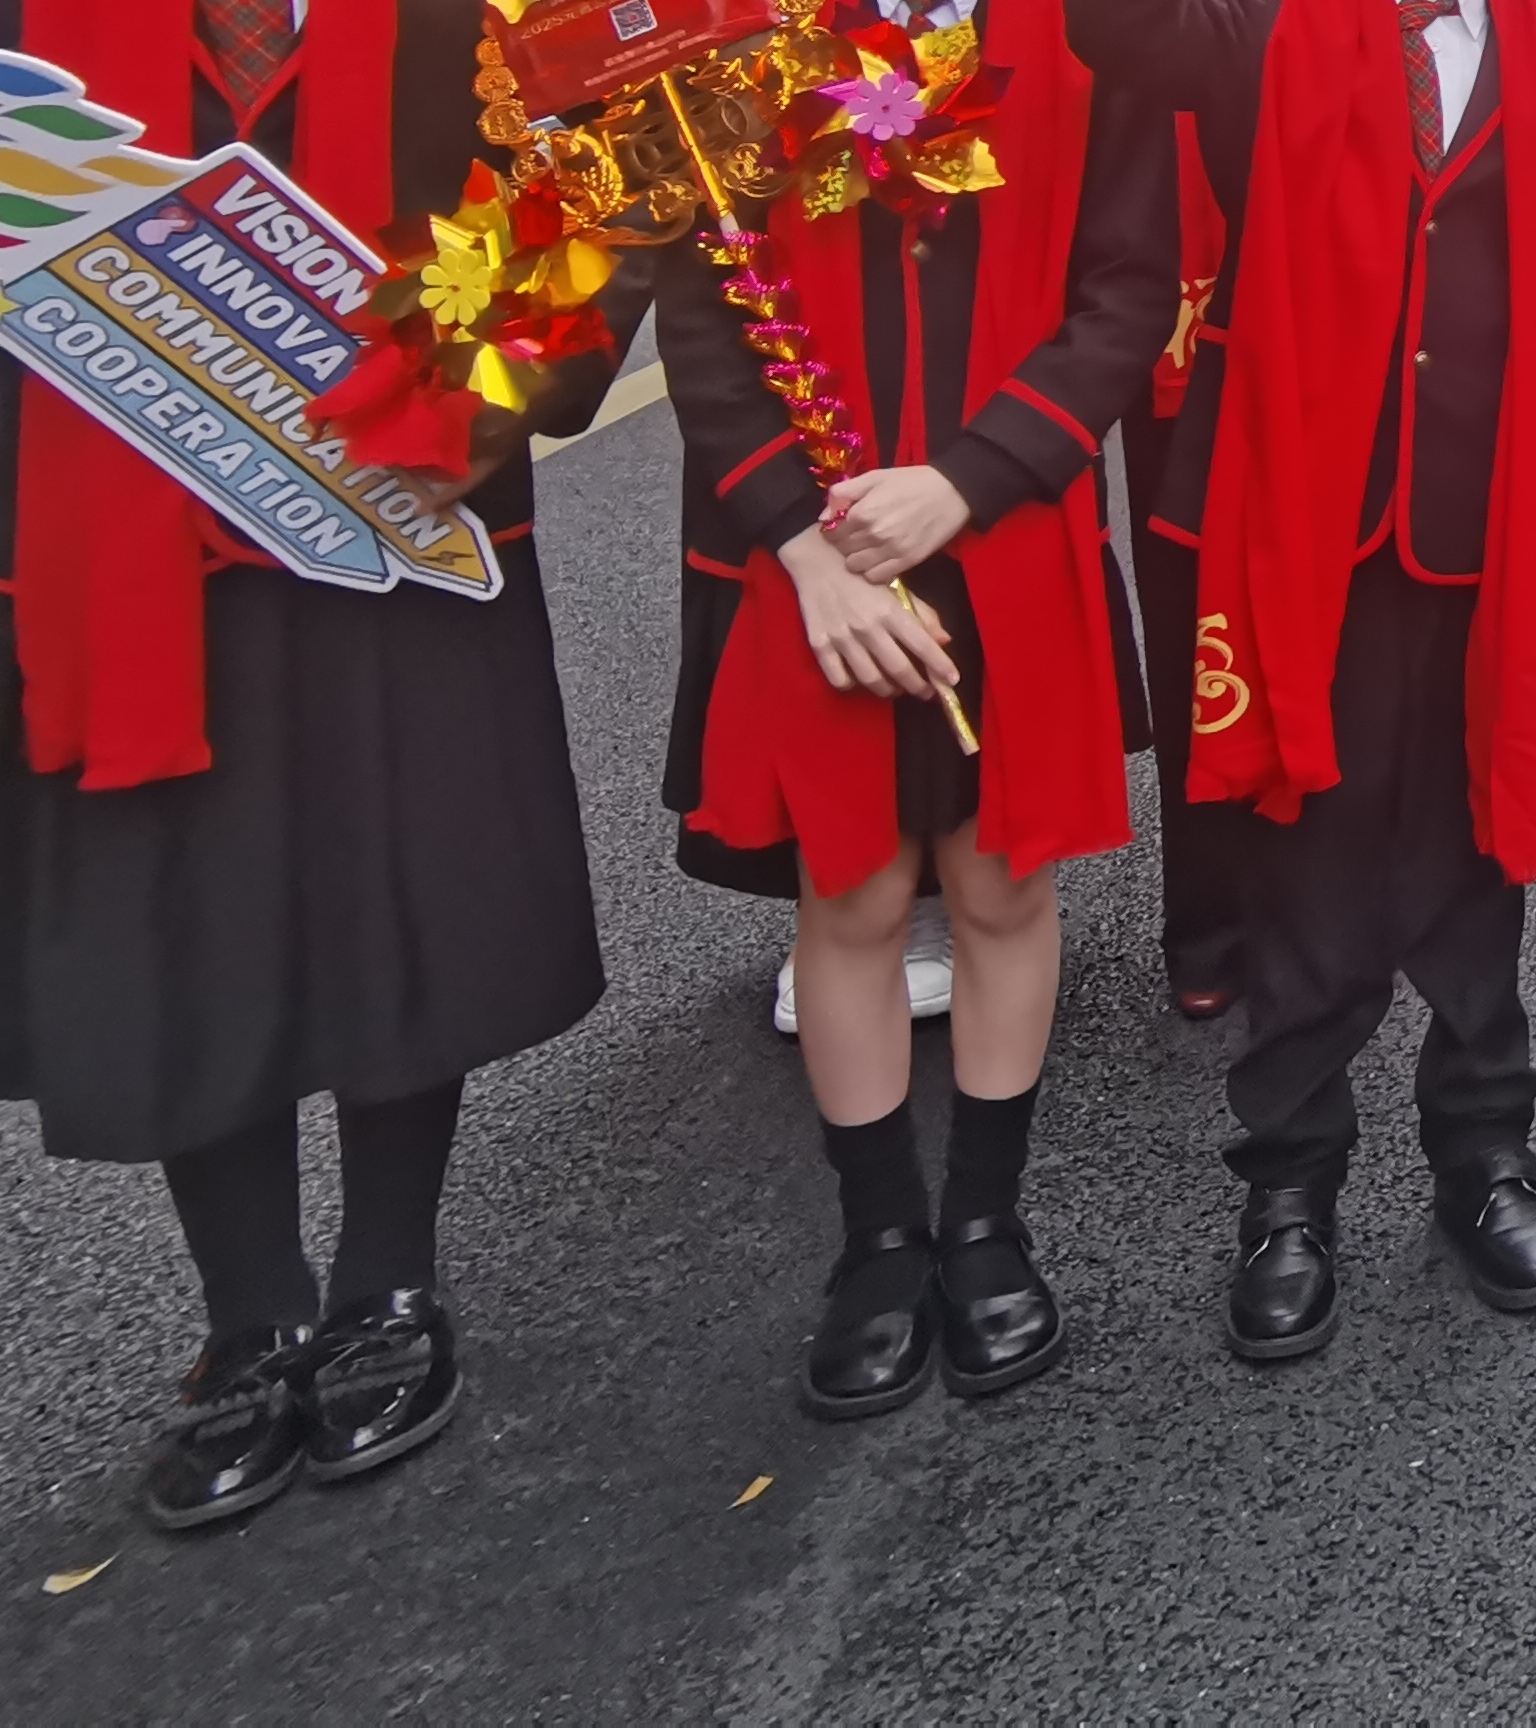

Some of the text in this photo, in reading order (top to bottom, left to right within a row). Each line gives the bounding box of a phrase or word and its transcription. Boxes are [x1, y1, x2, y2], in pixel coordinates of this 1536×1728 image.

[165, 232, 352, 382] INNOVA
[213, 174, 372, 317] VISION
[22, 297, 361, 558] COOPERATION
